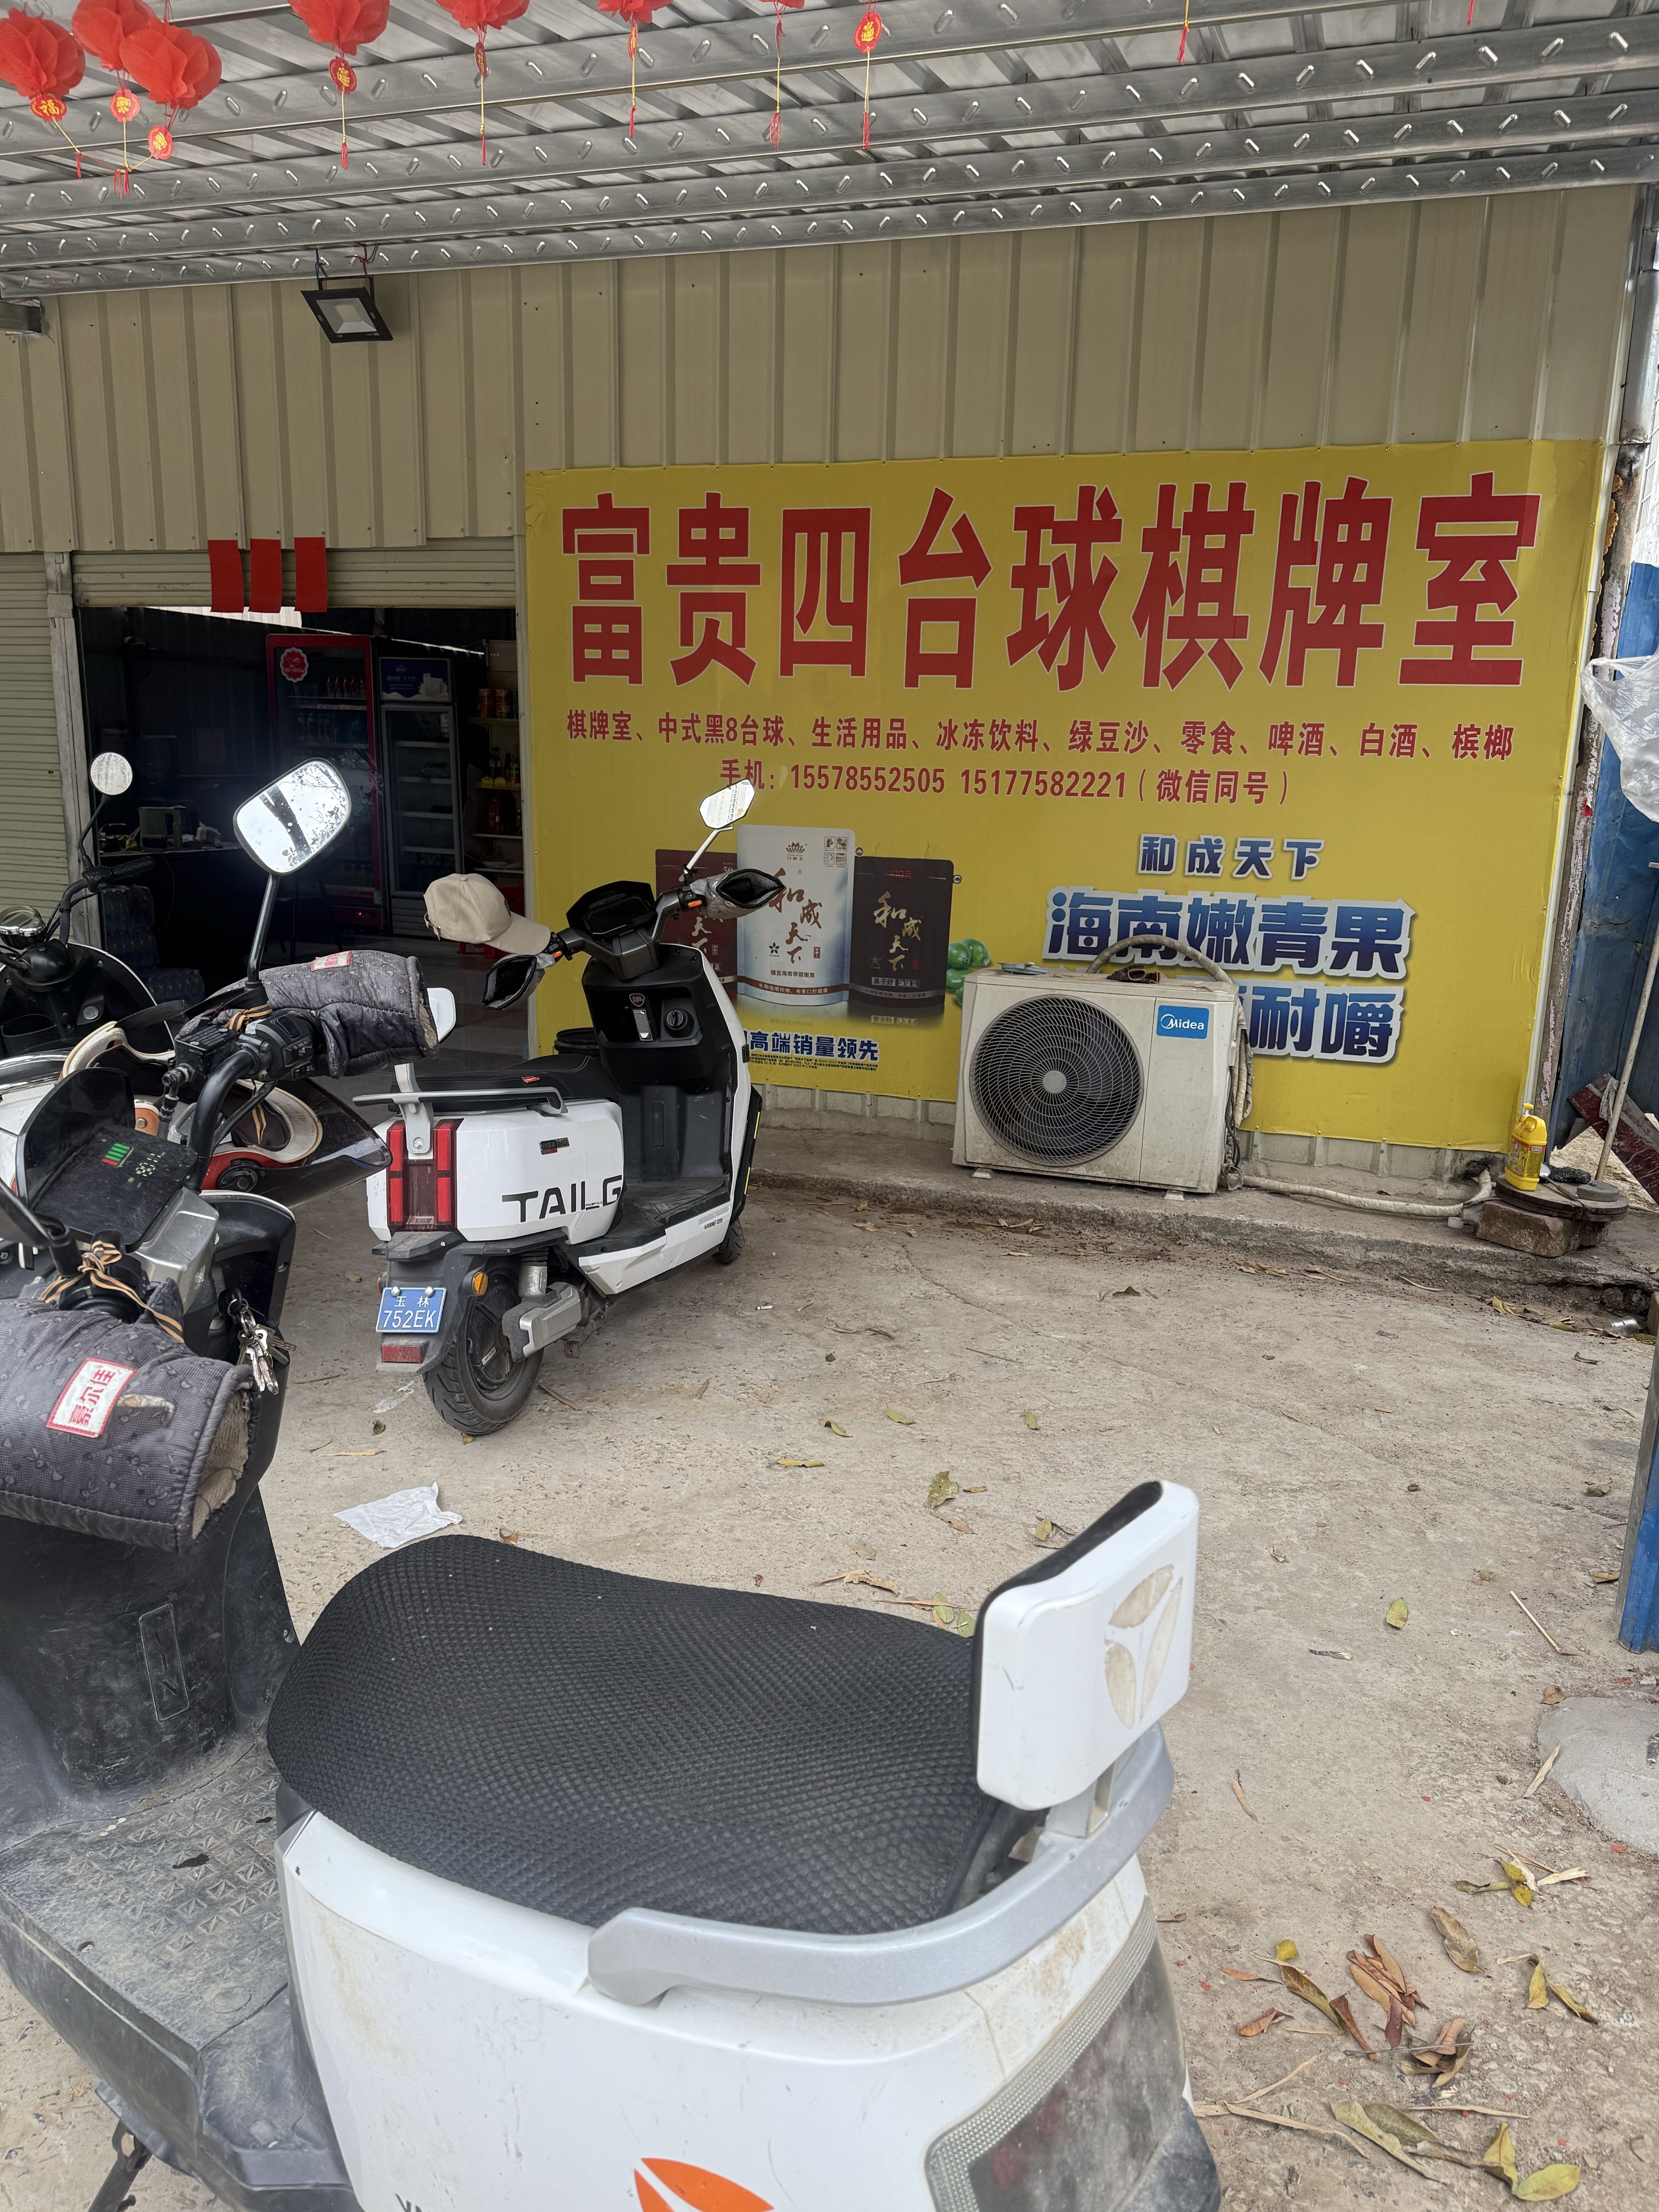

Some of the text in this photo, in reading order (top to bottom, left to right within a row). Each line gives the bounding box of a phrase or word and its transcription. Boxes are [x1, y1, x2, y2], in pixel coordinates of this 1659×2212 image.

[39, 98, 60, 115] 福
[562, 471, 1541, 692] 富贵四台球棋牌室
[1141, 835, 1322, 877] 和成天下
[873, 891, 922, 972] 和成天下
[1048, 892, 1403, 973] 海南嫩青果
[1160, 1014, 1205, 1030] Midea
[1239, 985, 1396, 1058] 耐嚼
[743, 1030, 879, 1061] 高端销量领先
[502, 1175, 622, 1223] TAILG
[383, 1310, 436, 1329] 752EK
[394, 1295, 430, 1308] 玉林
